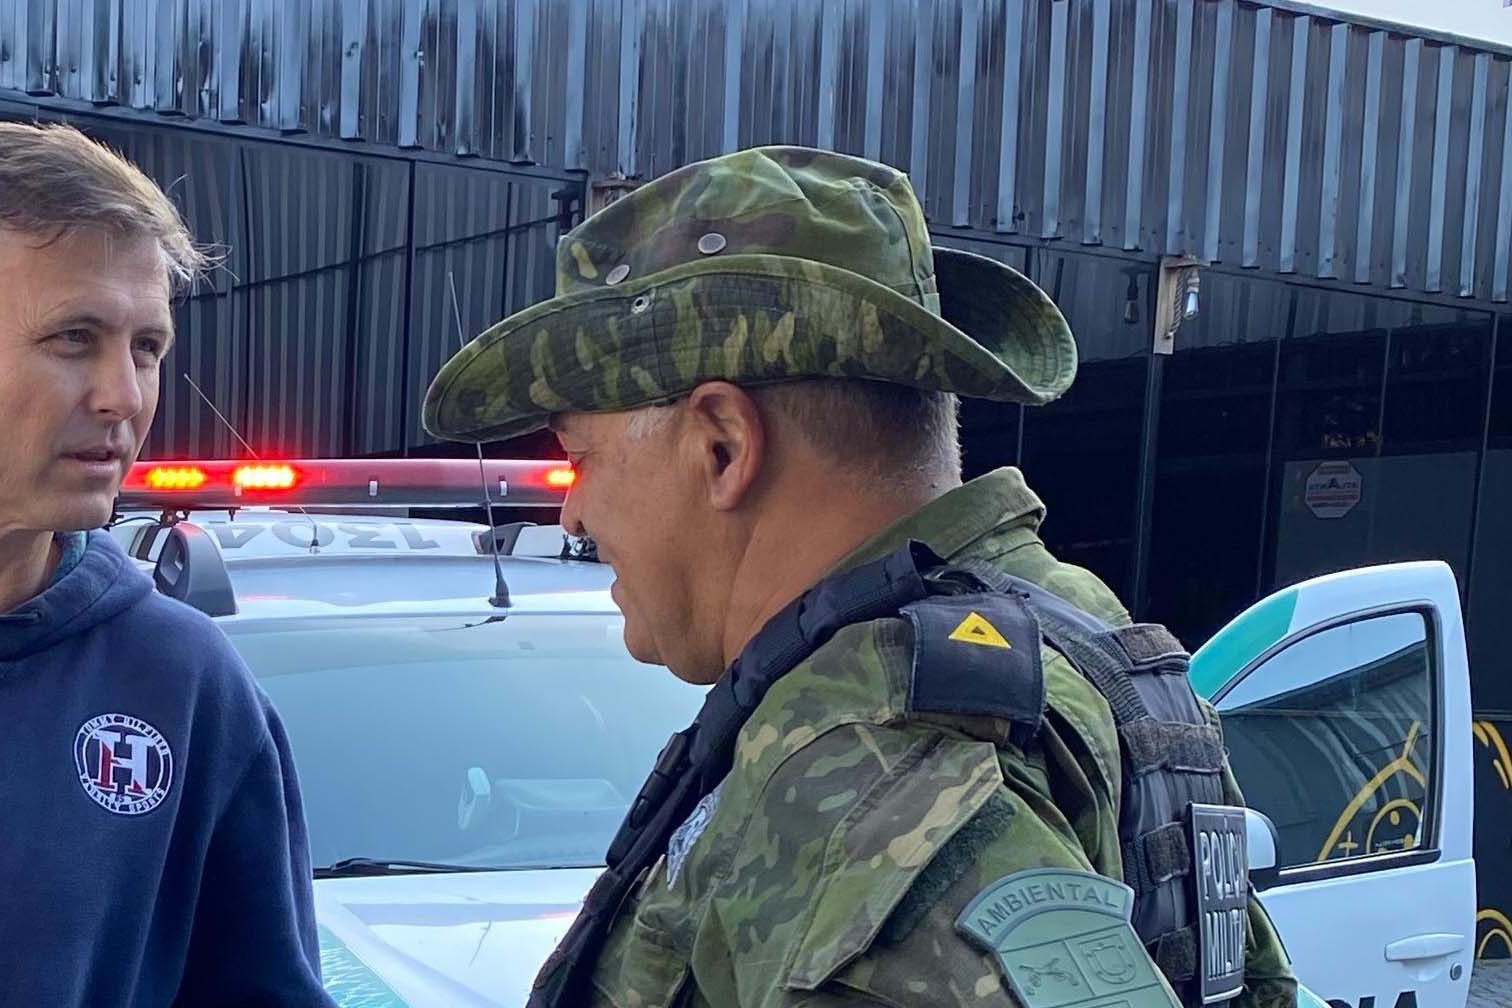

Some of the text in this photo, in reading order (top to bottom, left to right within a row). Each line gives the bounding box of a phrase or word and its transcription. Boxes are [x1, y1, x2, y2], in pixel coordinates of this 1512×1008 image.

[209, 520, 440, 550] 1304
[91, 729, 156, 797] H
[128, 787, 166, 813] SPORTS
[977, 882, 1121, 936] AMBIENTAL
